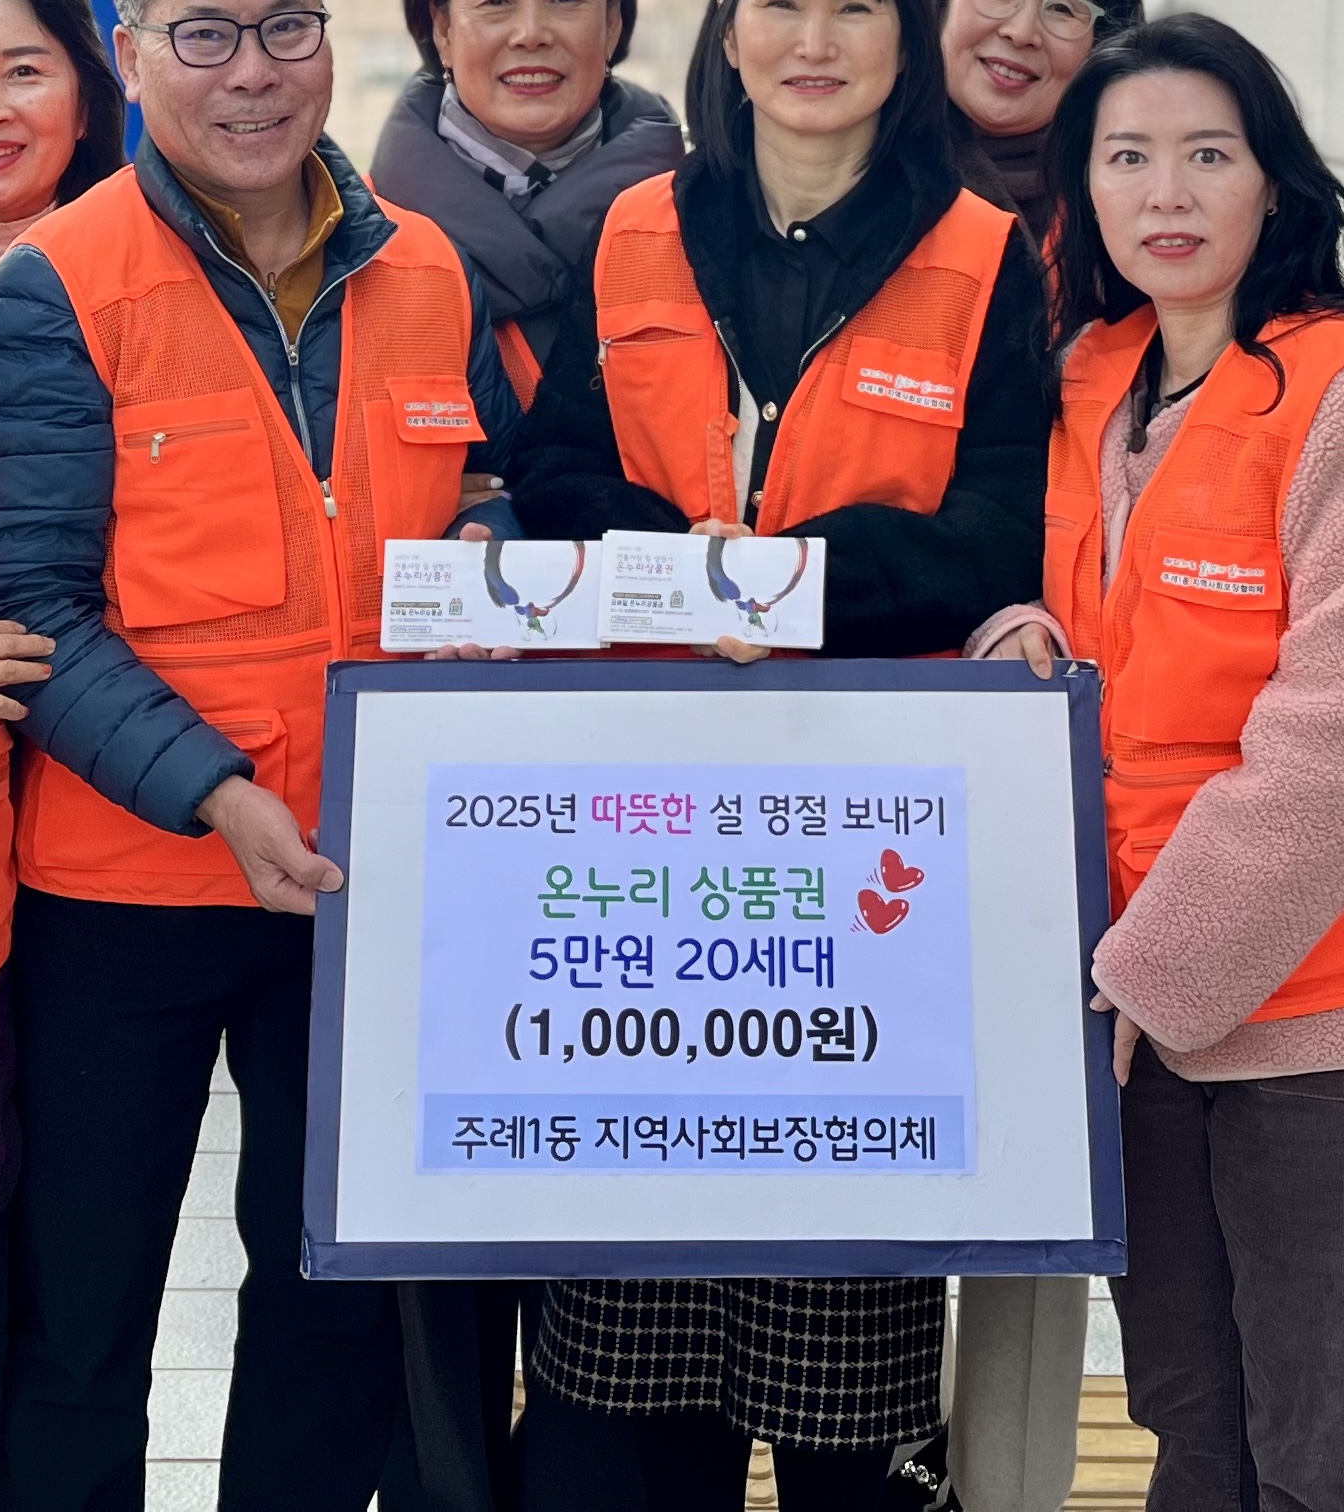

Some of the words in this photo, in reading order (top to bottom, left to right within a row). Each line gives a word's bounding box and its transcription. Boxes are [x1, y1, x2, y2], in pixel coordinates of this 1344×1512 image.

[394, 571, 452, 582] 온누리상품권
[445, 794, 578, 835] 2025년
[590, 792, 698, 835] 따뜻한
[709, 794, 743, 835] 설
[758, 794, 828, 836] 명절
[841, 795, 946, 835] 보내기
[537, 864, 670, 920] 온누리
[688, 865, 826, 921] 상품권
[529, 934, 655, 989] 5만원
[674, 935, 836, 989] 20세대
[504, 1002, 879, 1065] (1,000,000원)
[451, 1115, 582, 1163] 주례1동
[594, 1115, 937, 1163] 지역사회보장협의체
